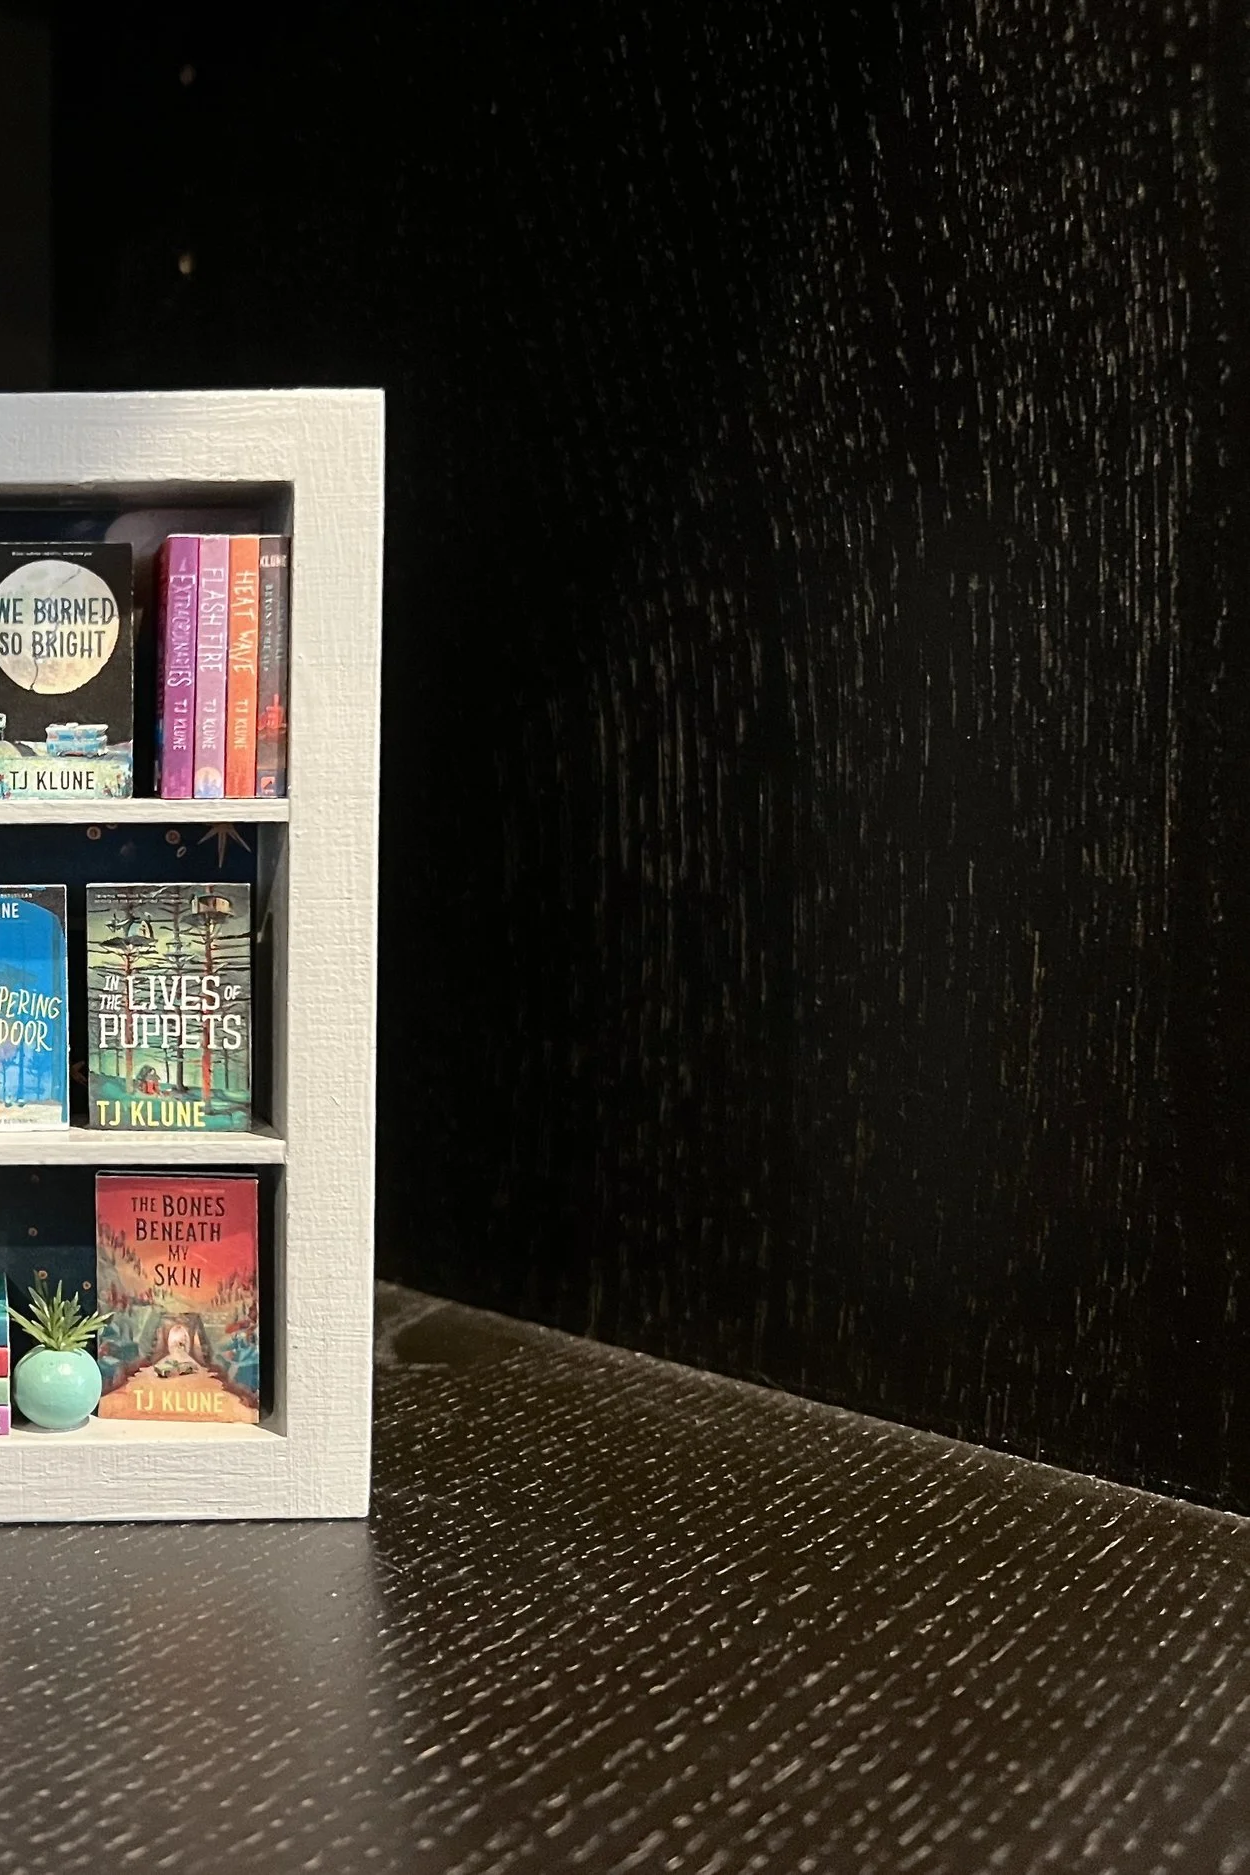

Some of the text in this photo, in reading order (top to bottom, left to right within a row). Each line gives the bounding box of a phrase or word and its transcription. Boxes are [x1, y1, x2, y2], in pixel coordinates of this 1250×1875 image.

[34, 597, 115, 625] BURNED
[0, 630, 107, 658] SO BRIGHT
[198, 567, 225, 750] FLASH FIRE TJ KLUNE
[229, 570, 257, 750] HEAT WAVE TJ KLUNE
[174, 699, 188, 713] TJ
[172, 717, 188, 751] KLUNE
[9, 771, 95, 790] TJ KLUNE
[99, 975, 241, 1011] THE LIVES OF
[103, 975, 118, 991] IN
[98, 1013, 242, 1049] PUPPETS
[97, 1100, 206, 1127] TJ KLUNE
[131, 1195, 225, 1217] THE BONES
[136, 1218, 221, 1242] BENEATH
[168, 1245, 190, 1261] MY
[154, 1264, 202, 1288] SKIN
[133, 1389, 225, 1413] TJ KLUNE
